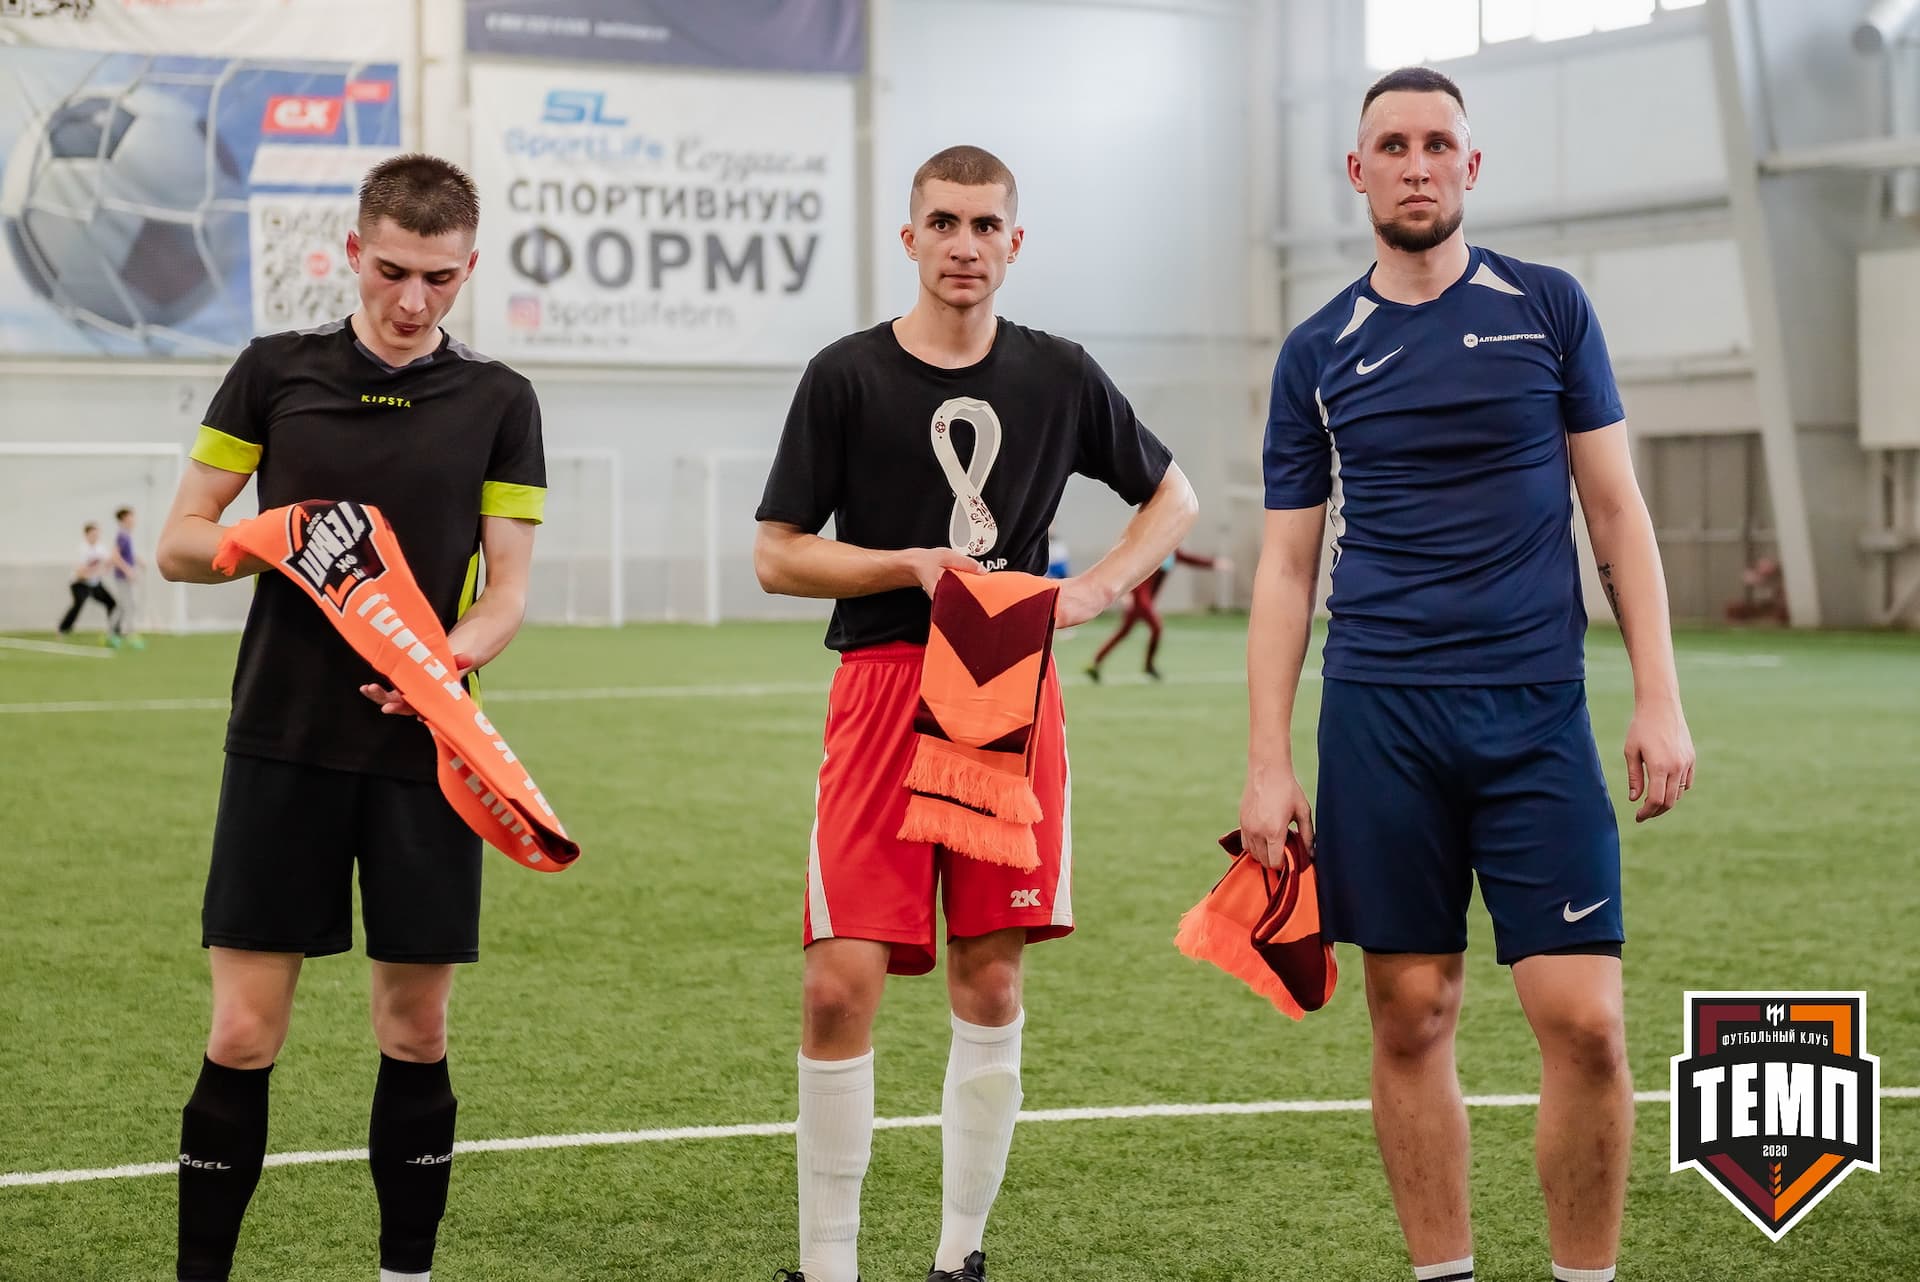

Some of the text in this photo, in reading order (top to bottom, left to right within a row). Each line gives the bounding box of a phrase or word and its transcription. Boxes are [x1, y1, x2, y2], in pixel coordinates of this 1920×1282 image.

[541, 90, 628, 127] SL
[507, 178, 823, 223] СПОРТИВНУЮ
[510, 227, 820, 294] ФОРМУ
[361, 394, 411, 408] KIPSTA
[297, 501, 366, 589] ТЕМП
[1010, 889, 1041, 907] 2K
